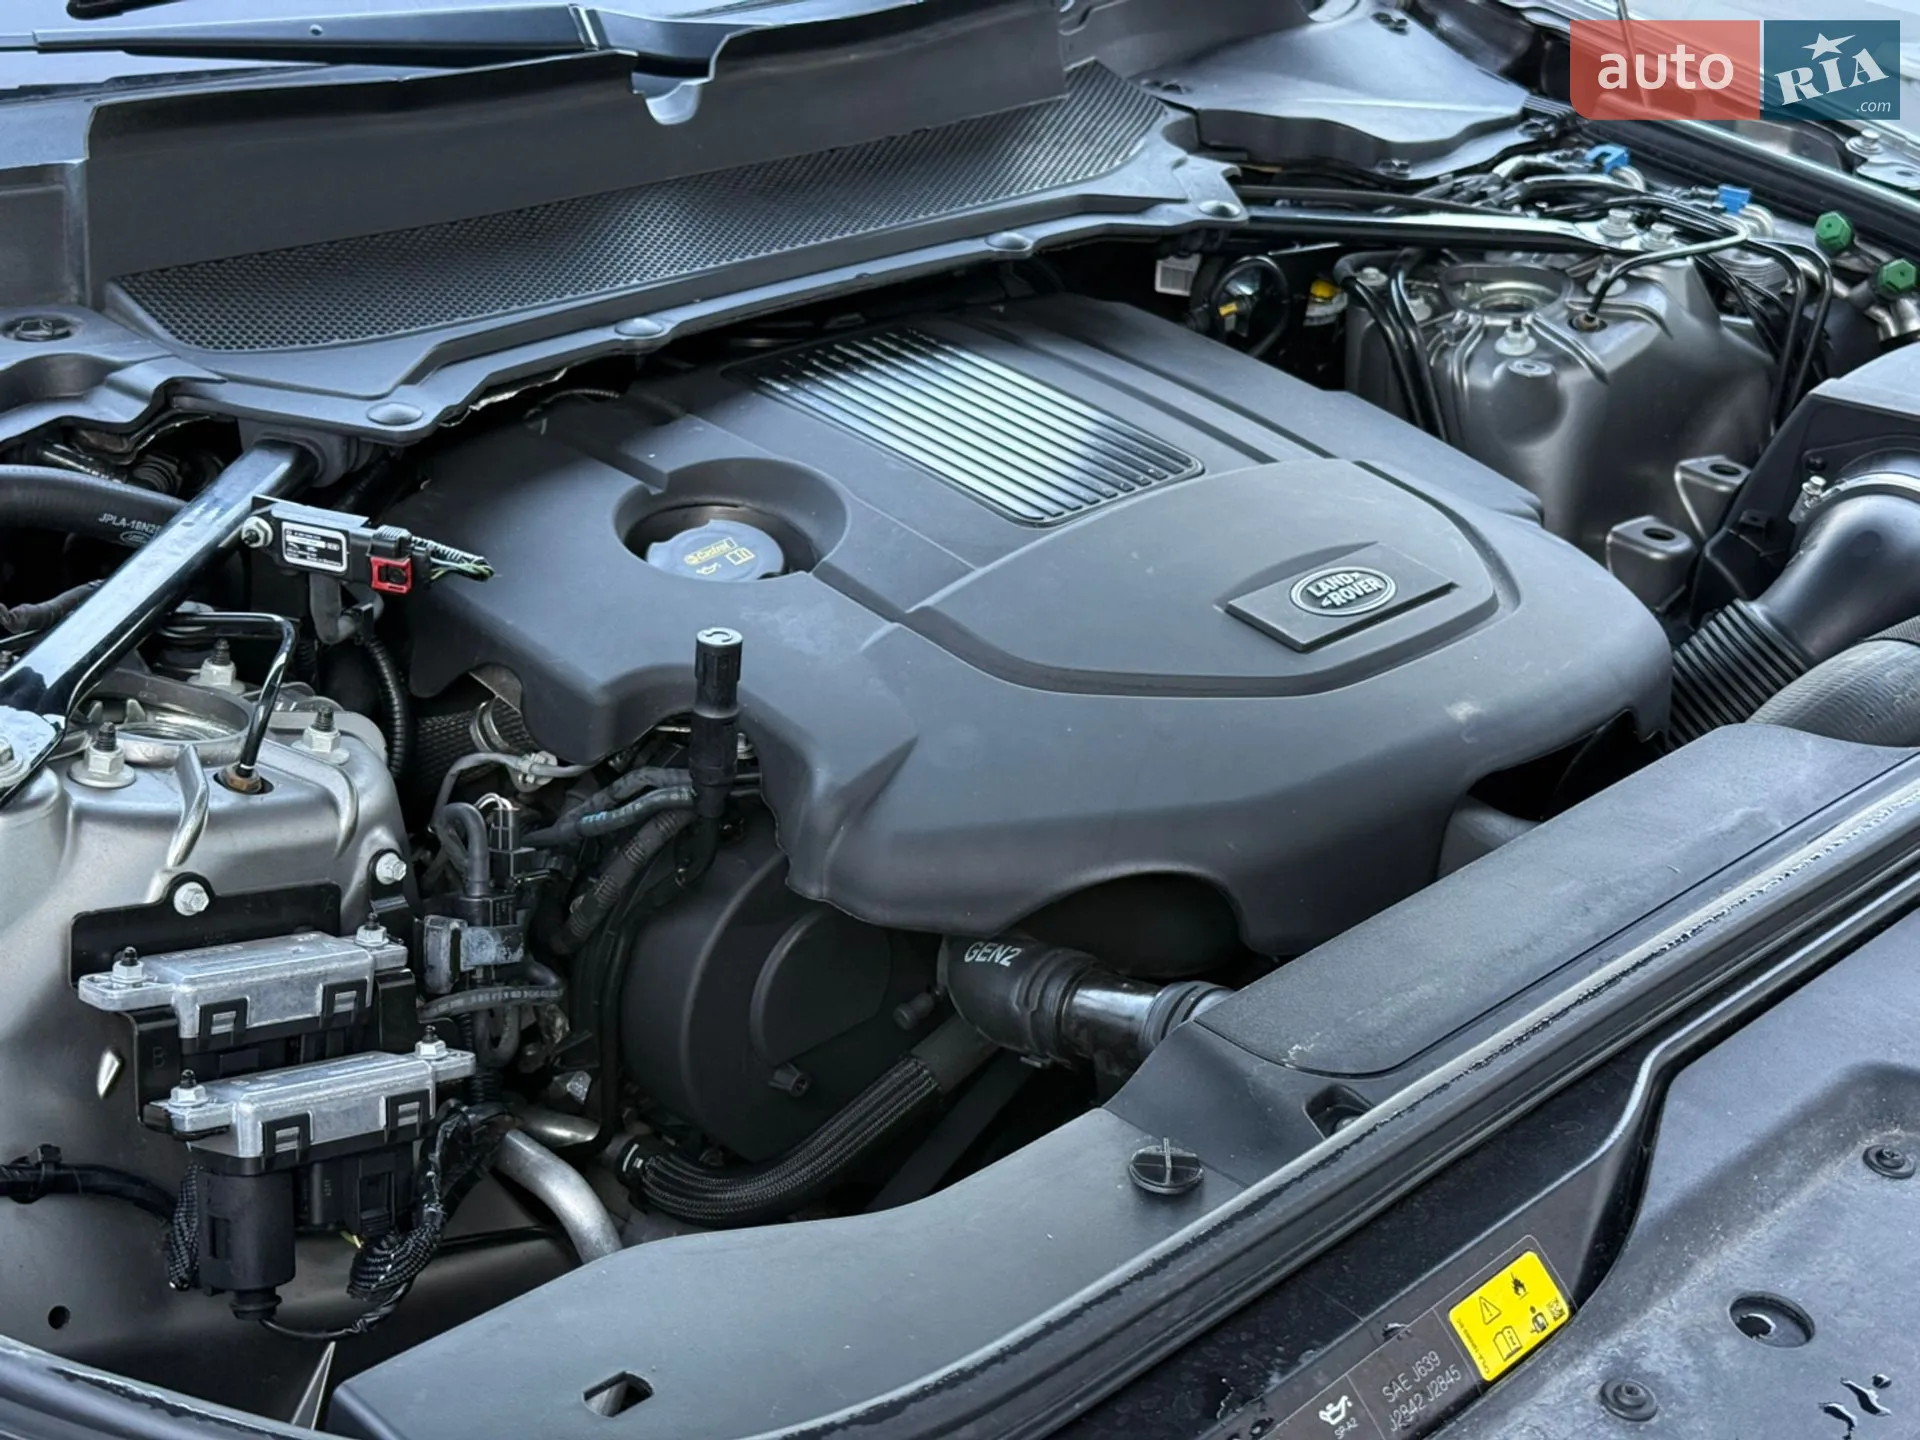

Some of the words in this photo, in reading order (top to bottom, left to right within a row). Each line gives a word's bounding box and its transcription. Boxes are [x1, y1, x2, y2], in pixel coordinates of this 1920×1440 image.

[1307, 573, 1352, 597] LAND
[1327, 578, 1384, 606] ROVER
[964, 941, 1022, 967] GEN2
[1382, 1373, 1412, 1402] SAE
[1412, 1351, 1440, 1382] J639
[1389, 1393, 1427, 1432] J2842
[1426, 1364, 1461, 1402] J2845
